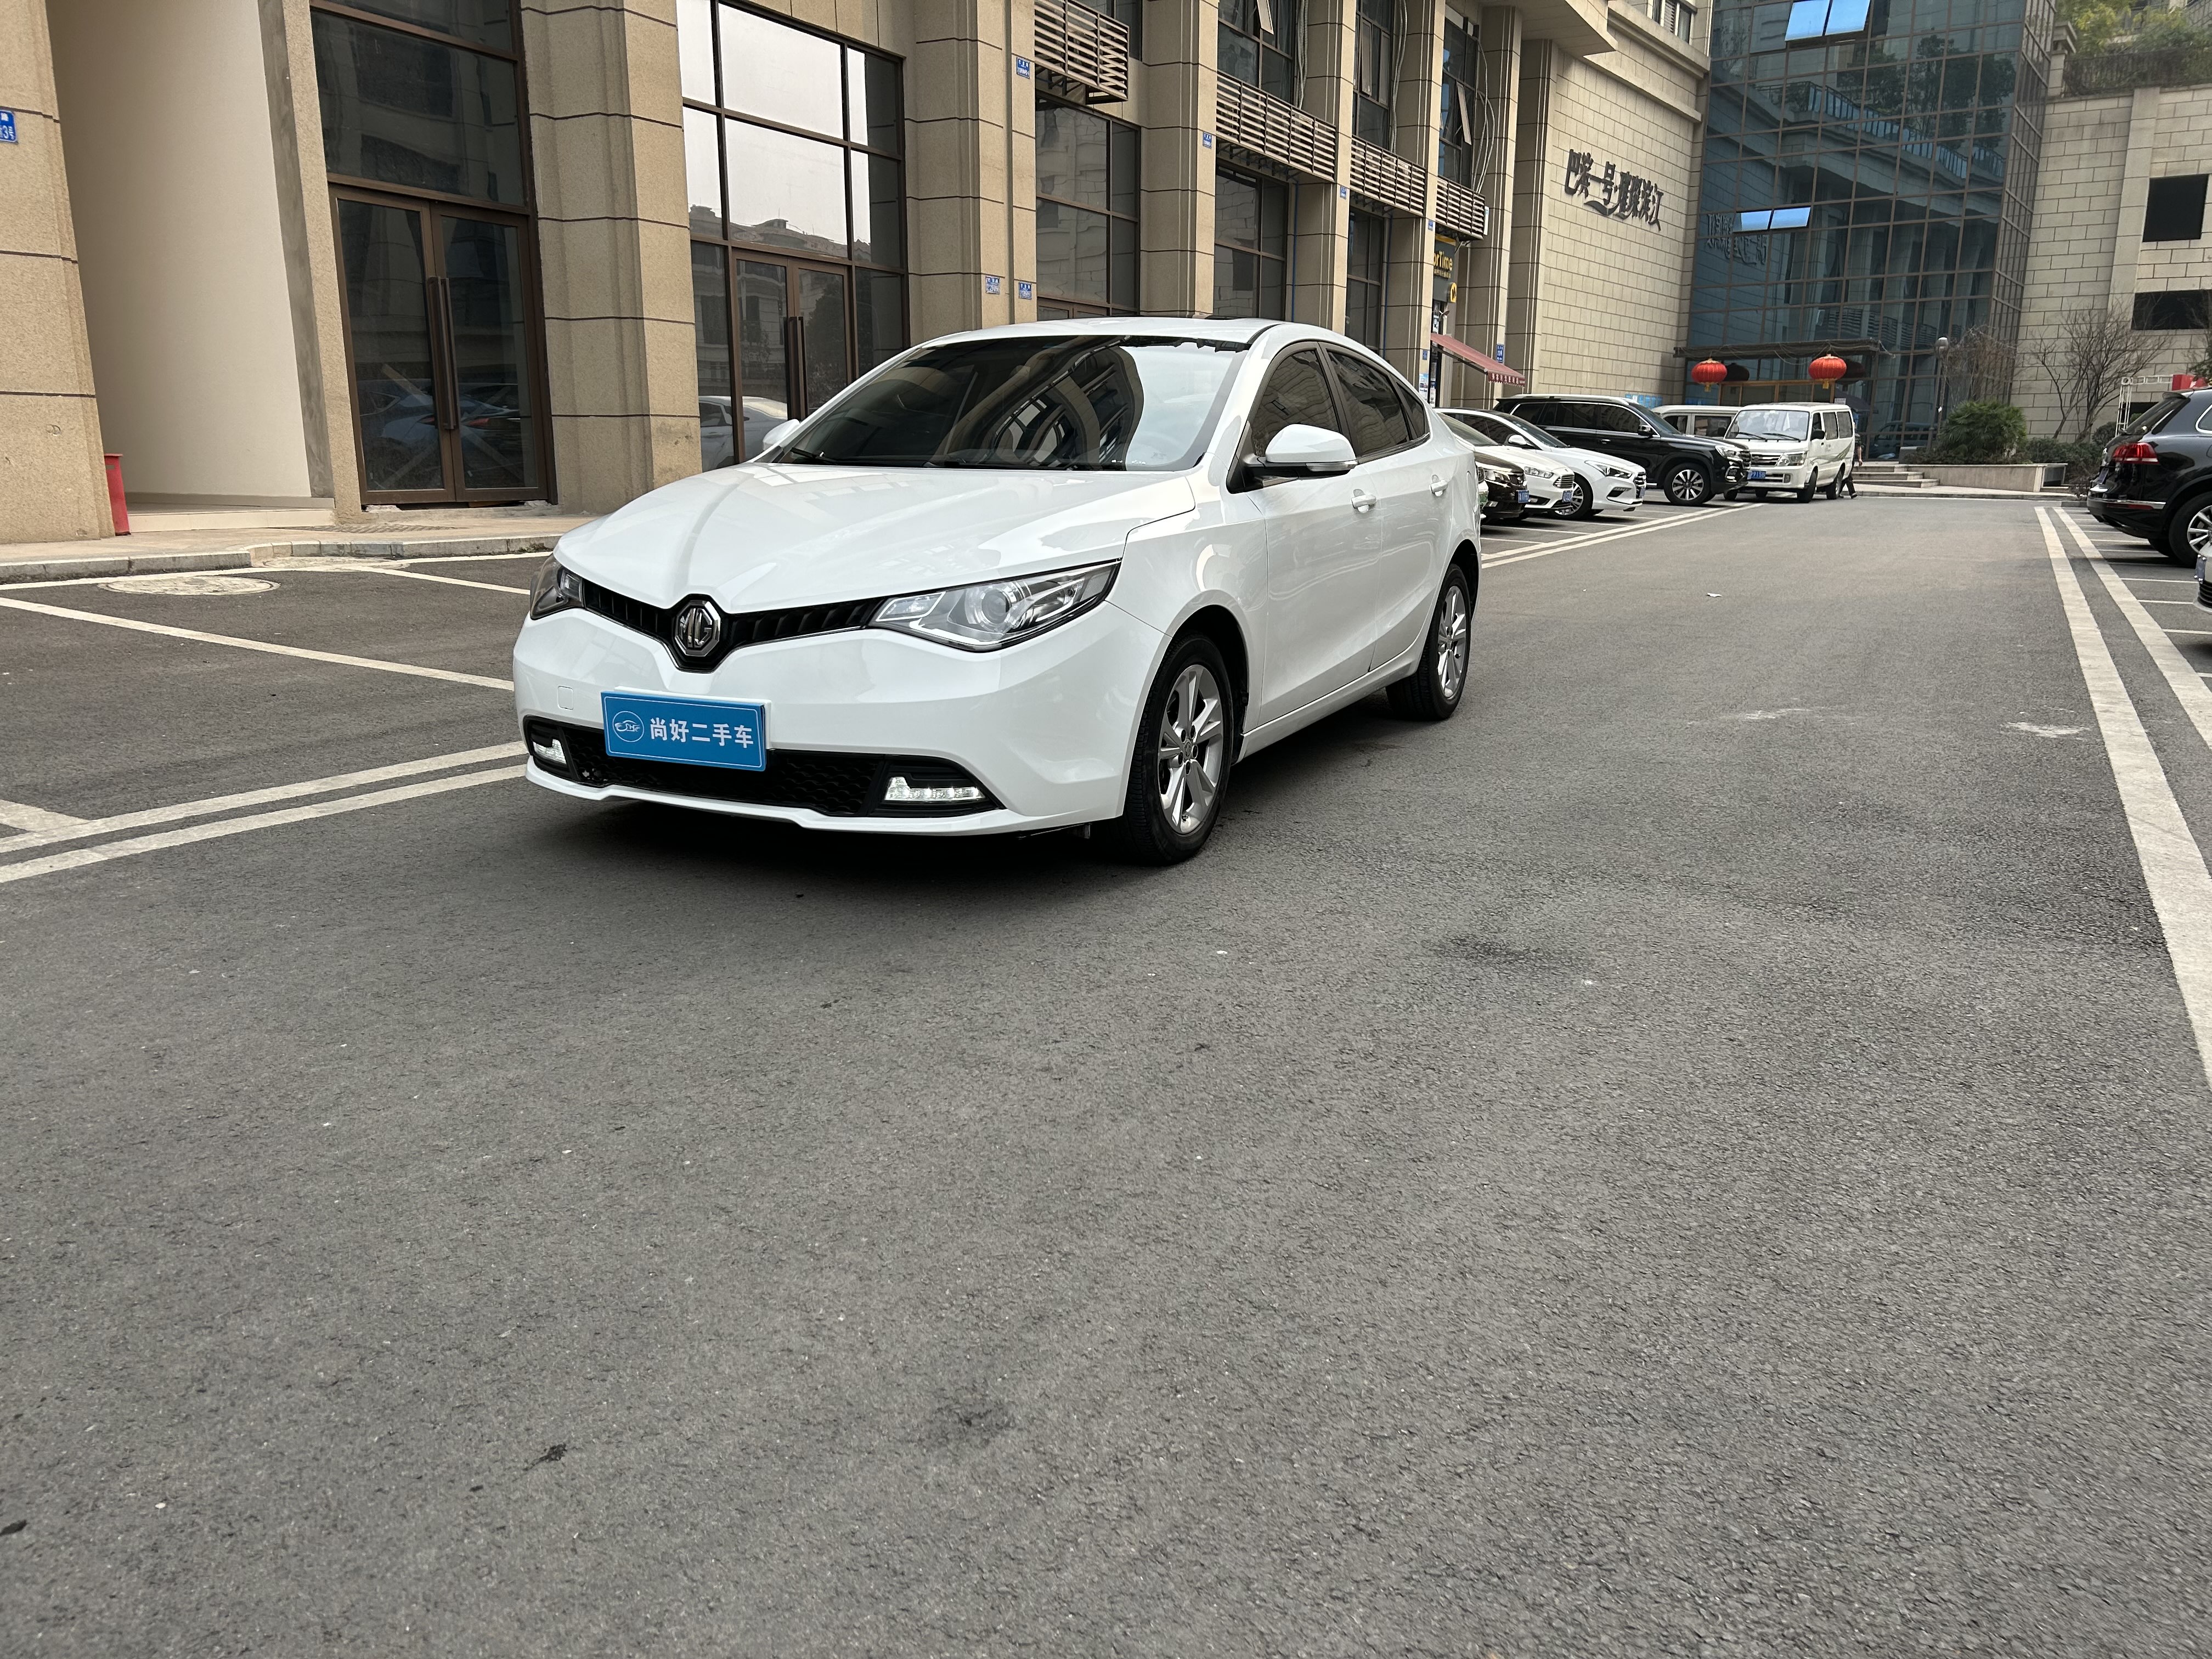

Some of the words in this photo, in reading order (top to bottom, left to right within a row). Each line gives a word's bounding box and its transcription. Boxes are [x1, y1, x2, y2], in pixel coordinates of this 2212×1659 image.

[680, 607, 713, 648] MG
[650, 717, 754, 748] 尚好二手车
